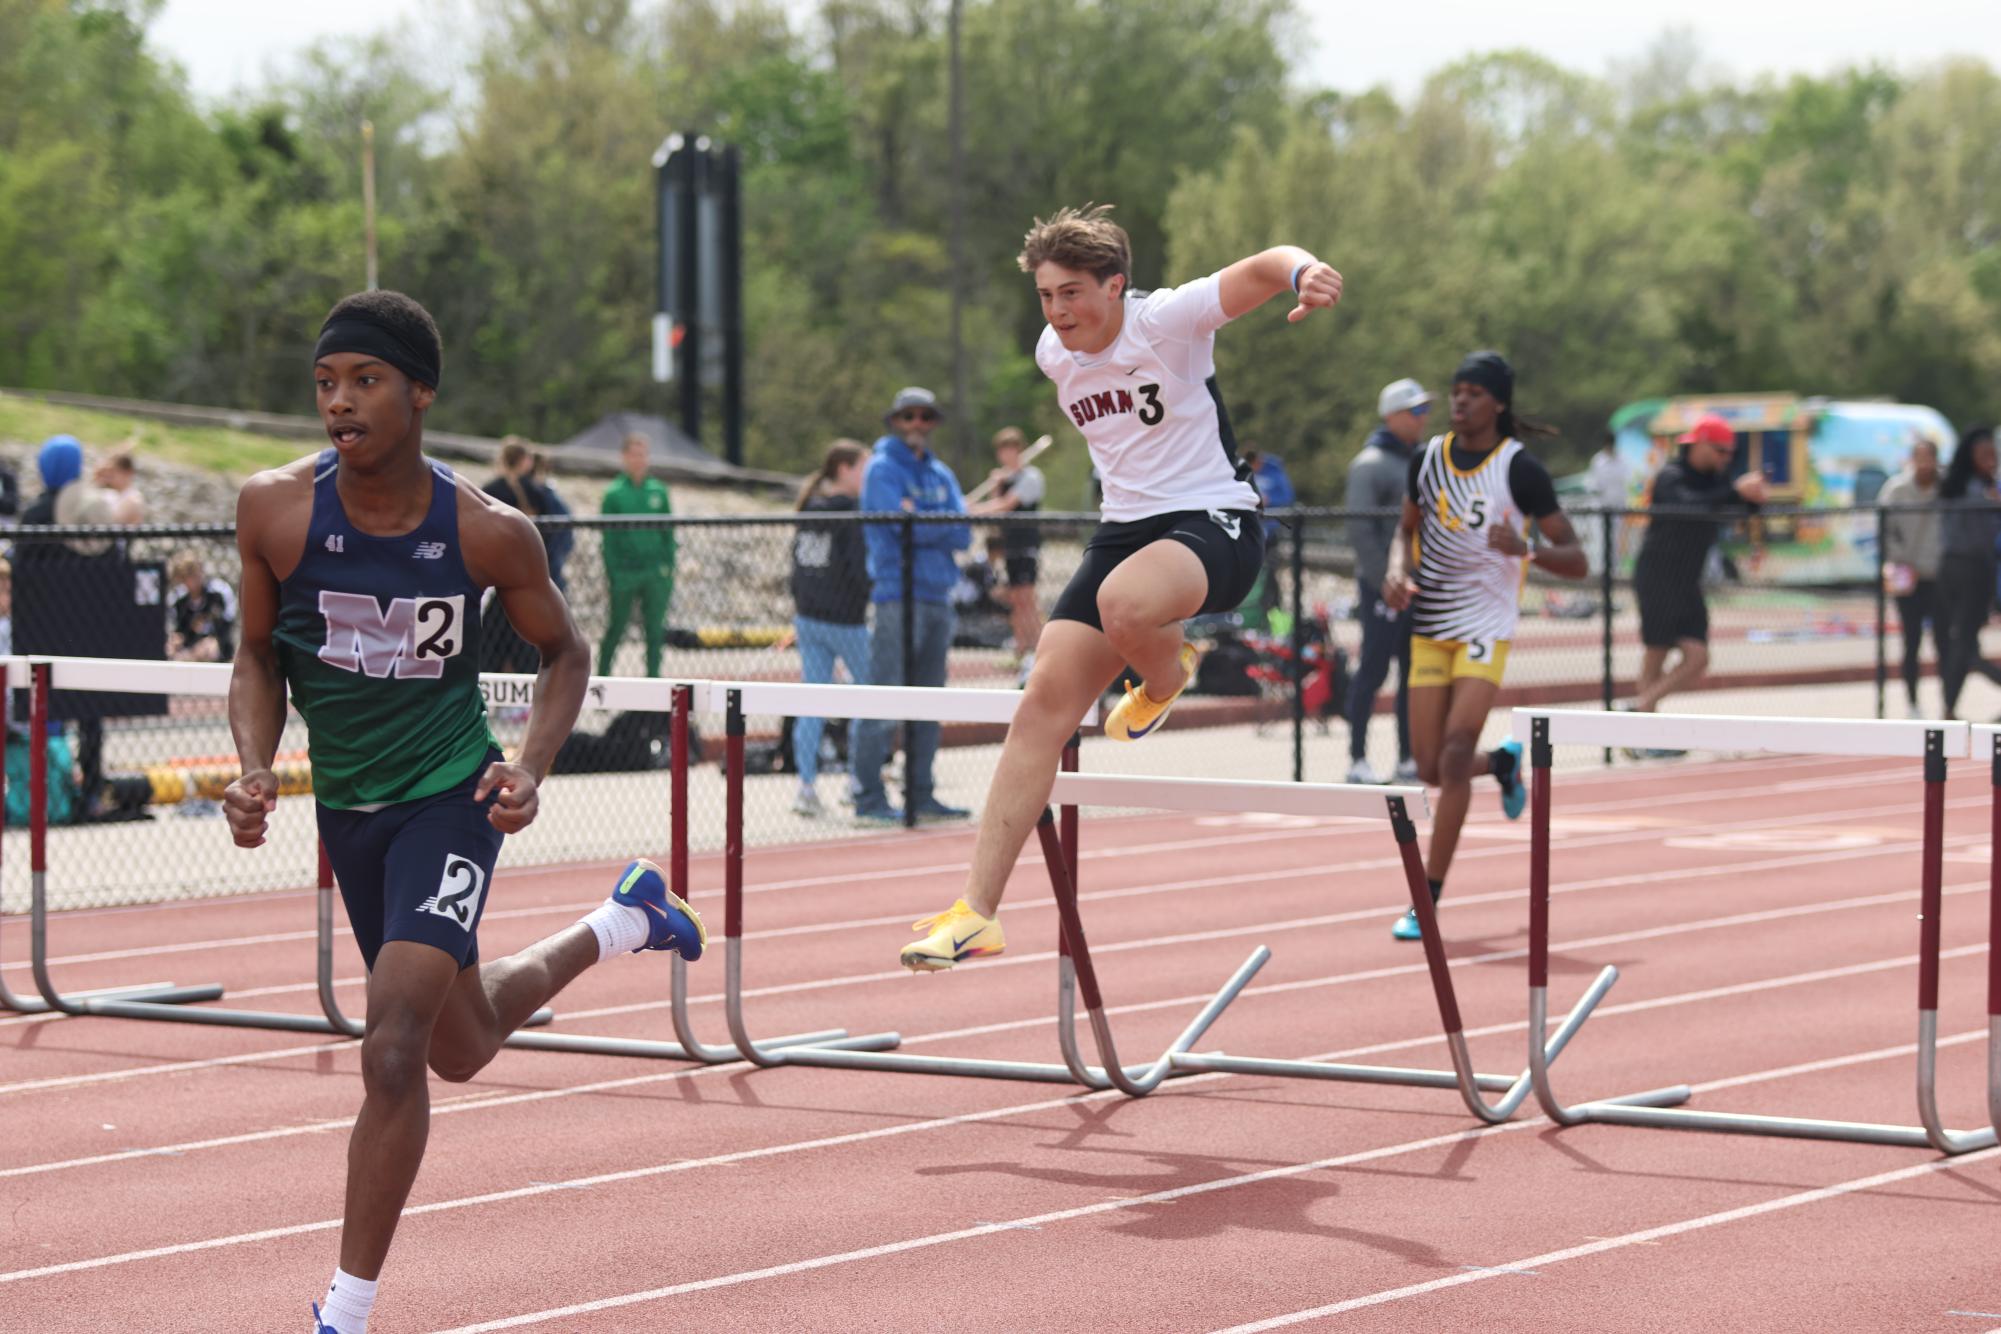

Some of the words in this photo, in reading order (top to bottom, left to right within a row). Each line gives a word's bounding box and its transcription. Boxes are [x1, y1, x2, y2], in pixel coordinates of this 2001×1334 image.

[1138, 383, 1164, 426] 3
[1468, 500, 1485, 529] 5
[324, 534, 344, 553] 41
[317, 590, 444, 679] M
[416, 600, 455, 658] 2
[479, 680, 536, 703] SUM
[437, 860, 477, 923] 2
